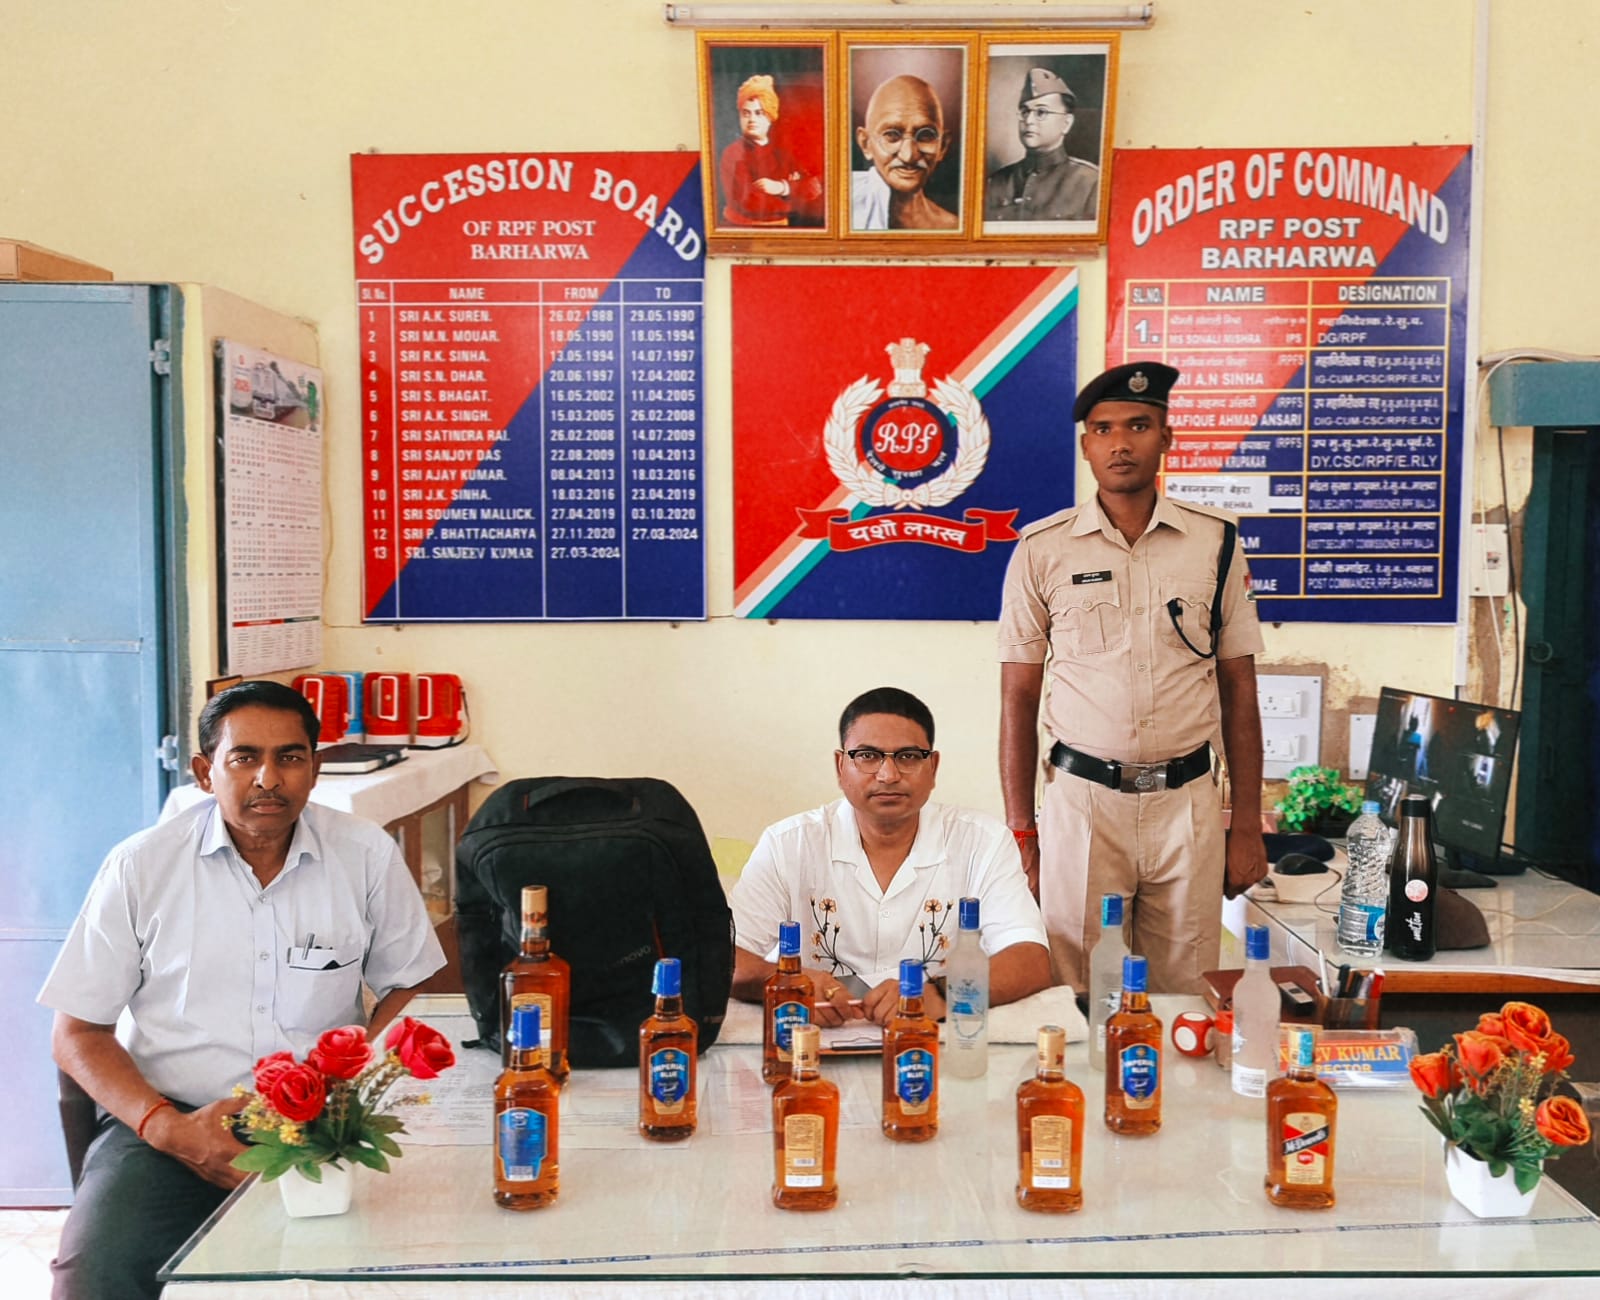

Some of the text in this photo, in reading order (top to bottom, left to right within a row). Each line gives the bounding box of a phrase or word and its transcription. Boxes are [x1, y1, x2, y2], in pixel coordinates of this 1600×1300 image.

[1131, 151, 1449, 247] ORDER OF COMMAND
[359, 158, 701, 265] SUCCESSION BOARD
[463, 220, 596, 237] OF RPF POST
[1219, 217, 1362, 240] RPF POST
[470, 244, 590, 261] BARHARWA
[1201, 246, 1378, 269] BARHARWA
[449, 287, 485, 300] NAME
[564, 287, 599, 300] FROM
[655, 287, 671, 299] TO
[1206, 286, 1265, 303] NAME
[1338, 285, 1437, 301] DESIGNATION
[368, 310, 375, 323] 1
[400, 310, 419, 323] SRI
[368, 330, 376, 343] 2
[400, 330, 420, 343] SRI
[1134, 319, 1160, 344] 1.
[1317, 332, 1368, 344] DG/RPF
[369, 350, 376, 363] 3
[401, 350, 420, 363] SRI
[369, 370, 377, 382] 4
[401, 370, 420, 382] SRI
[1222, 372, 1265, 385] SINHA
[370, 390, 377, 402] 5
[401, 390, 421, 402] SRI
[370, 410, 377, 422] 6
[402, 410, 421, 422] SRI
[1167, 413, 1302, 427] RAFIQUE AHMAD ANSARI
[371, 430, 377, 441] 7
[402, 430, 421, 441] SRI
[371, 450, 378, 461] 8
[402, 450, 501, 461] SRI SANJOY DAS
[371, 469, 378, 481] 9
[403, 469, 421, 481] SRI
[426, 469, 457, 481] AJAY
[372, 489, 386, 501] 10
[403, 489, 422, 501] SRI
[373, 508, 386, 520] 11
[403, 508, 422, 520] SRI
[426, 508, 477, 520] SOUMEN
[373, 528, 387, 540] 12
[404, 528, 423, 540] SRI
[441, 528, 536, 540] BHATTACHARYA
[374, 547, 387, 559] 13
[433, 547, 485, 559] SANJEEV
[490, 547, 534, 559] KUMAR
[1337, 1045, 1402, 1061] KUMAR
